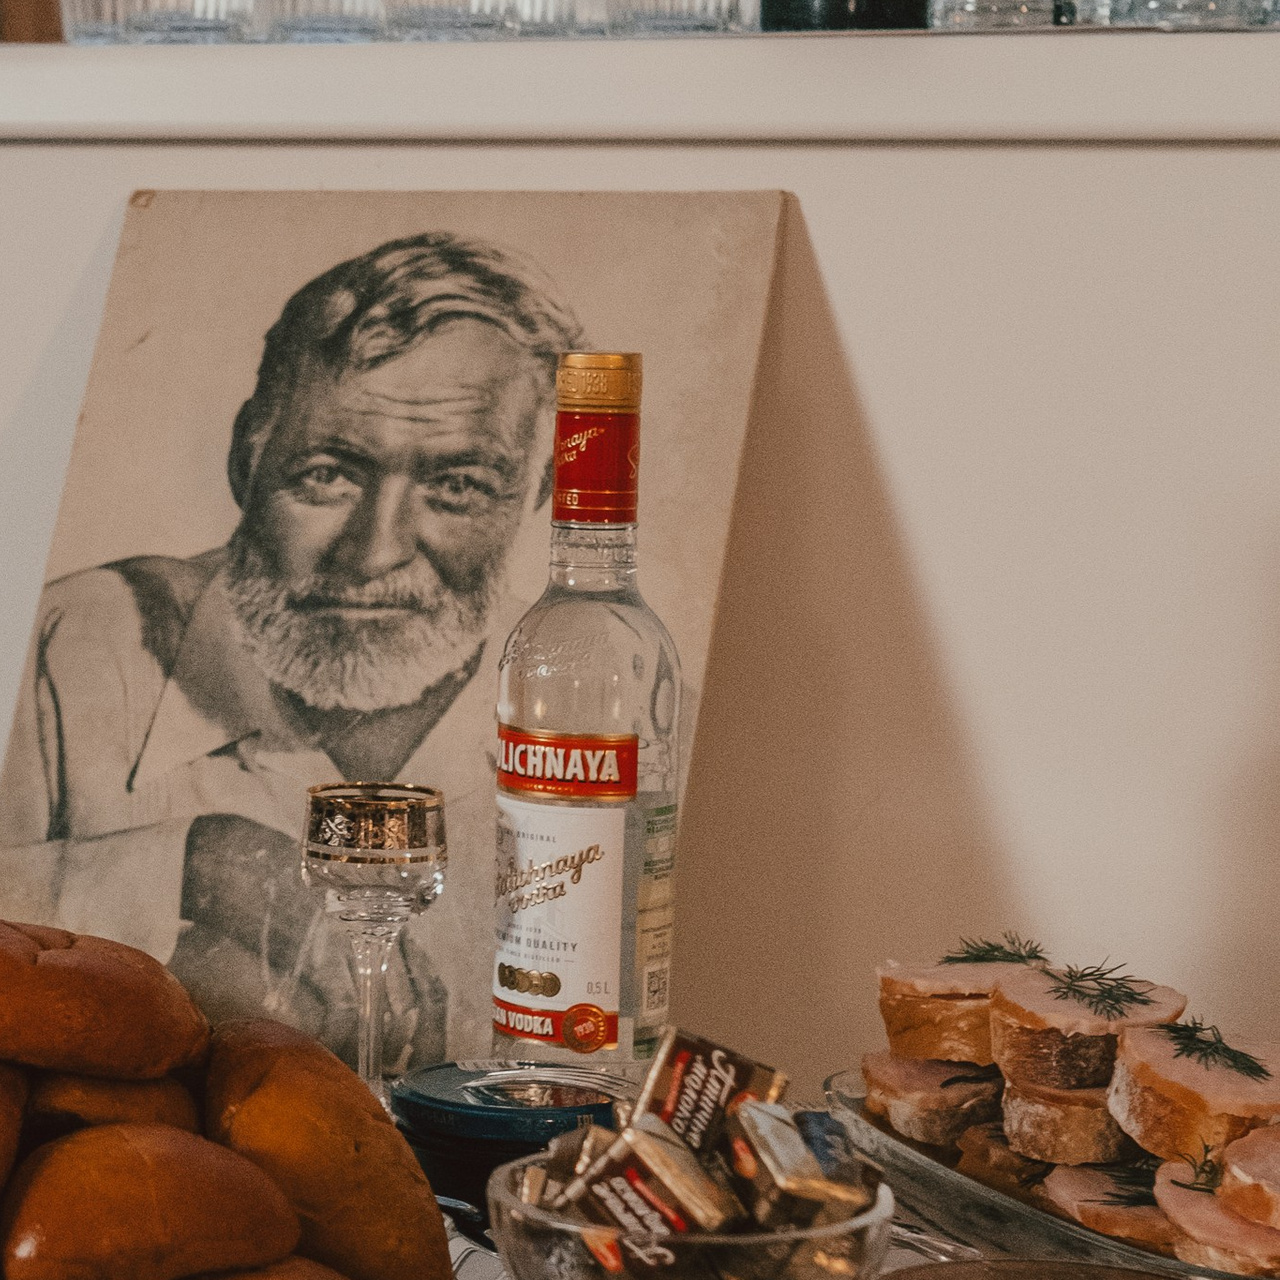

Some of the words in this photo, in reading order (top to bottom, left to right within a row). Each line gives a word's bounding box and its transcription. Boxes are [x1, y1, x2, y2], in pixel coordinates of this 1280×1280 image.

[508, 881, 567, 914] vodka
[526, 937, 579, 952] QUALITY
[508, 1010, 554, 1037] VODKA
